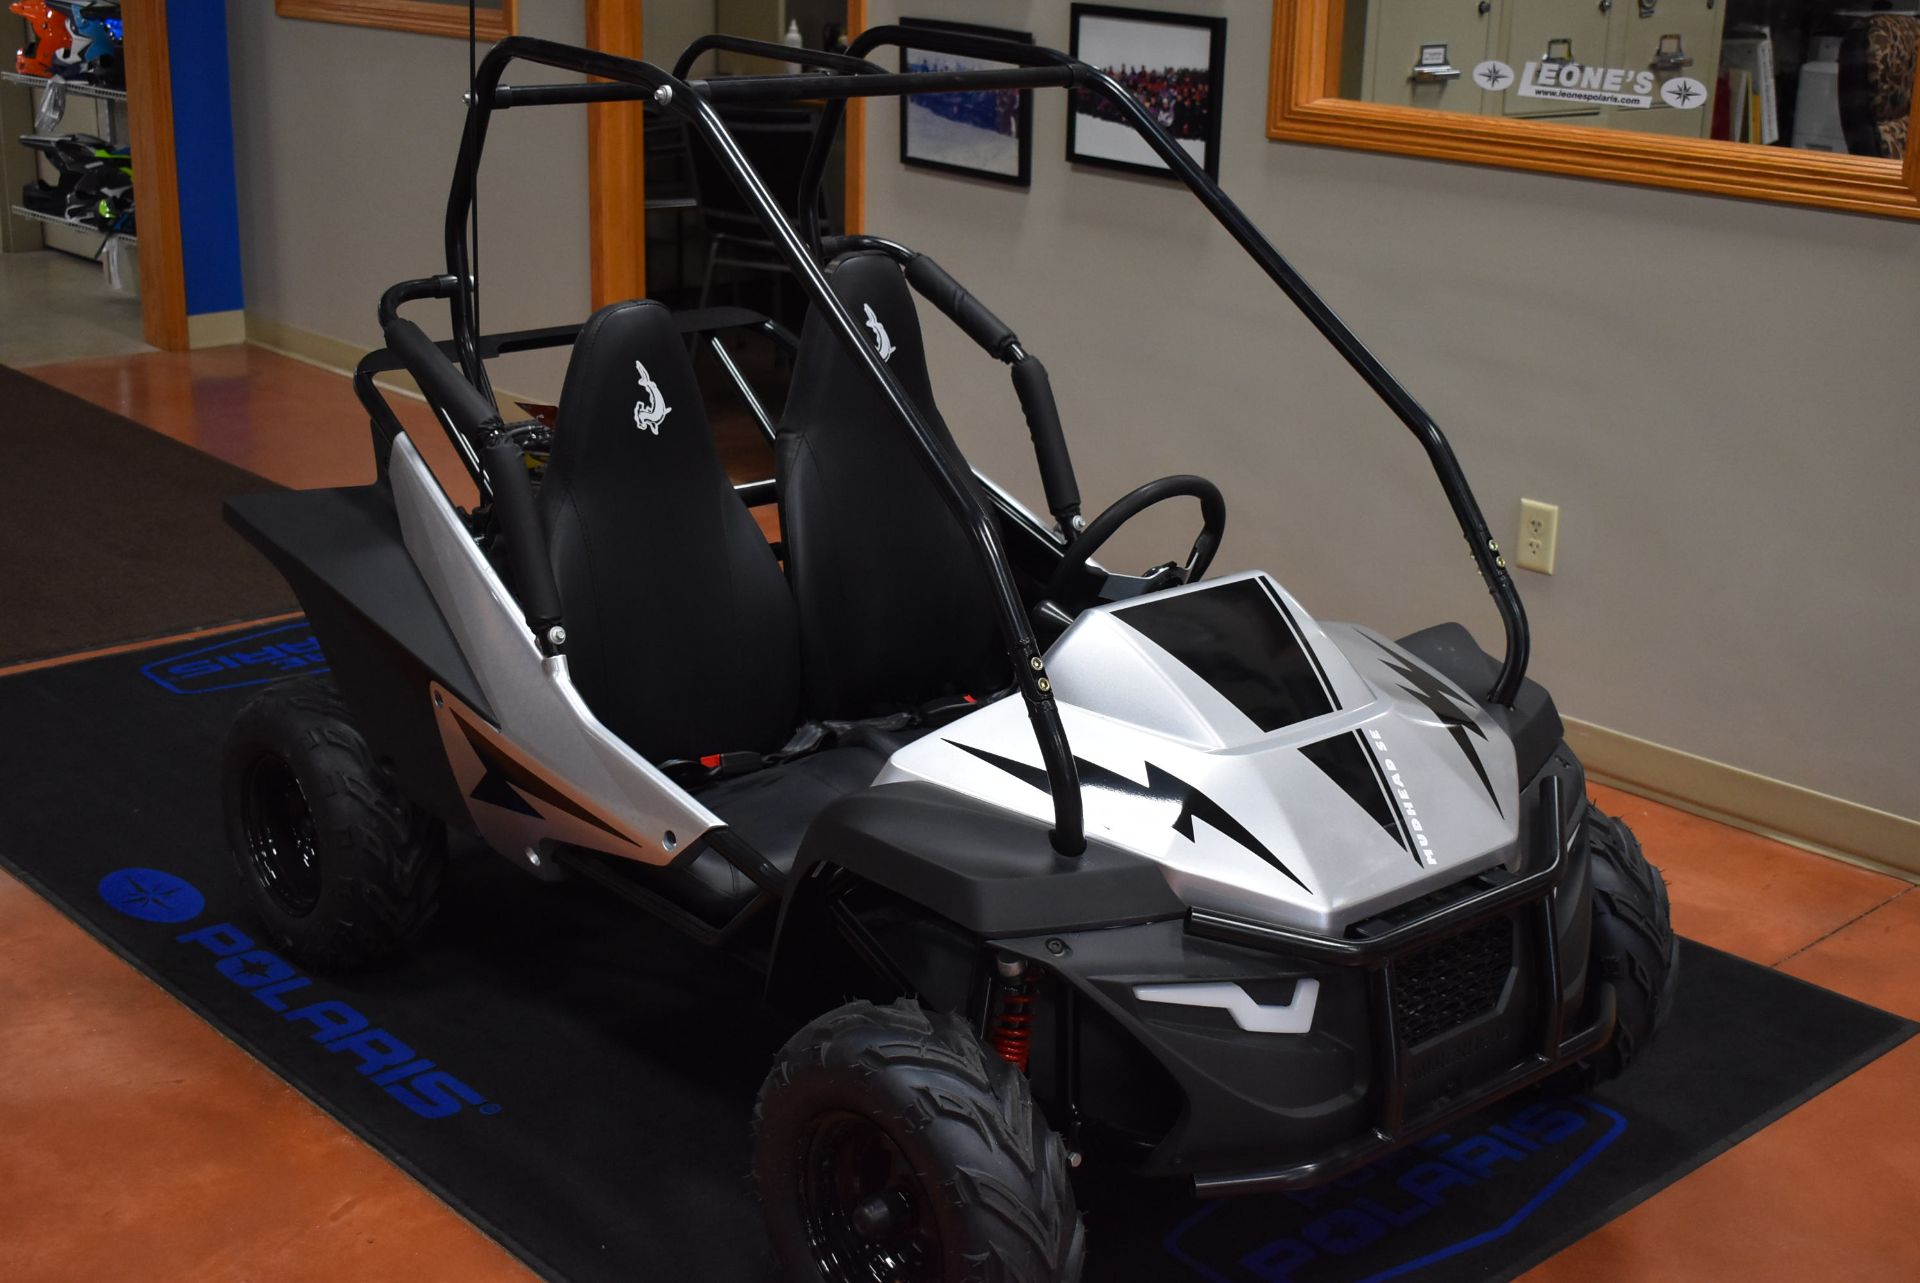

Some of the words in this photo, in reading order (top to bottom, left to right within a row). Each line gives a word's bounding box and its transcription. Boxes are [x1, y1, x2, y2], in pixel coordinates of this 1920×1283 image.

[1518, 61, 1655, 97] LEONE'S
[1535, 88, 1641, 105] www.leonespolaris.com
[1369, 729, 1388, 752] SE
[1384, 758, 1438, 865] MUDHEAD
[176, 922, 486, 1119] POLARIS
[1240, 1102, 1588, 1283] POLARIS
